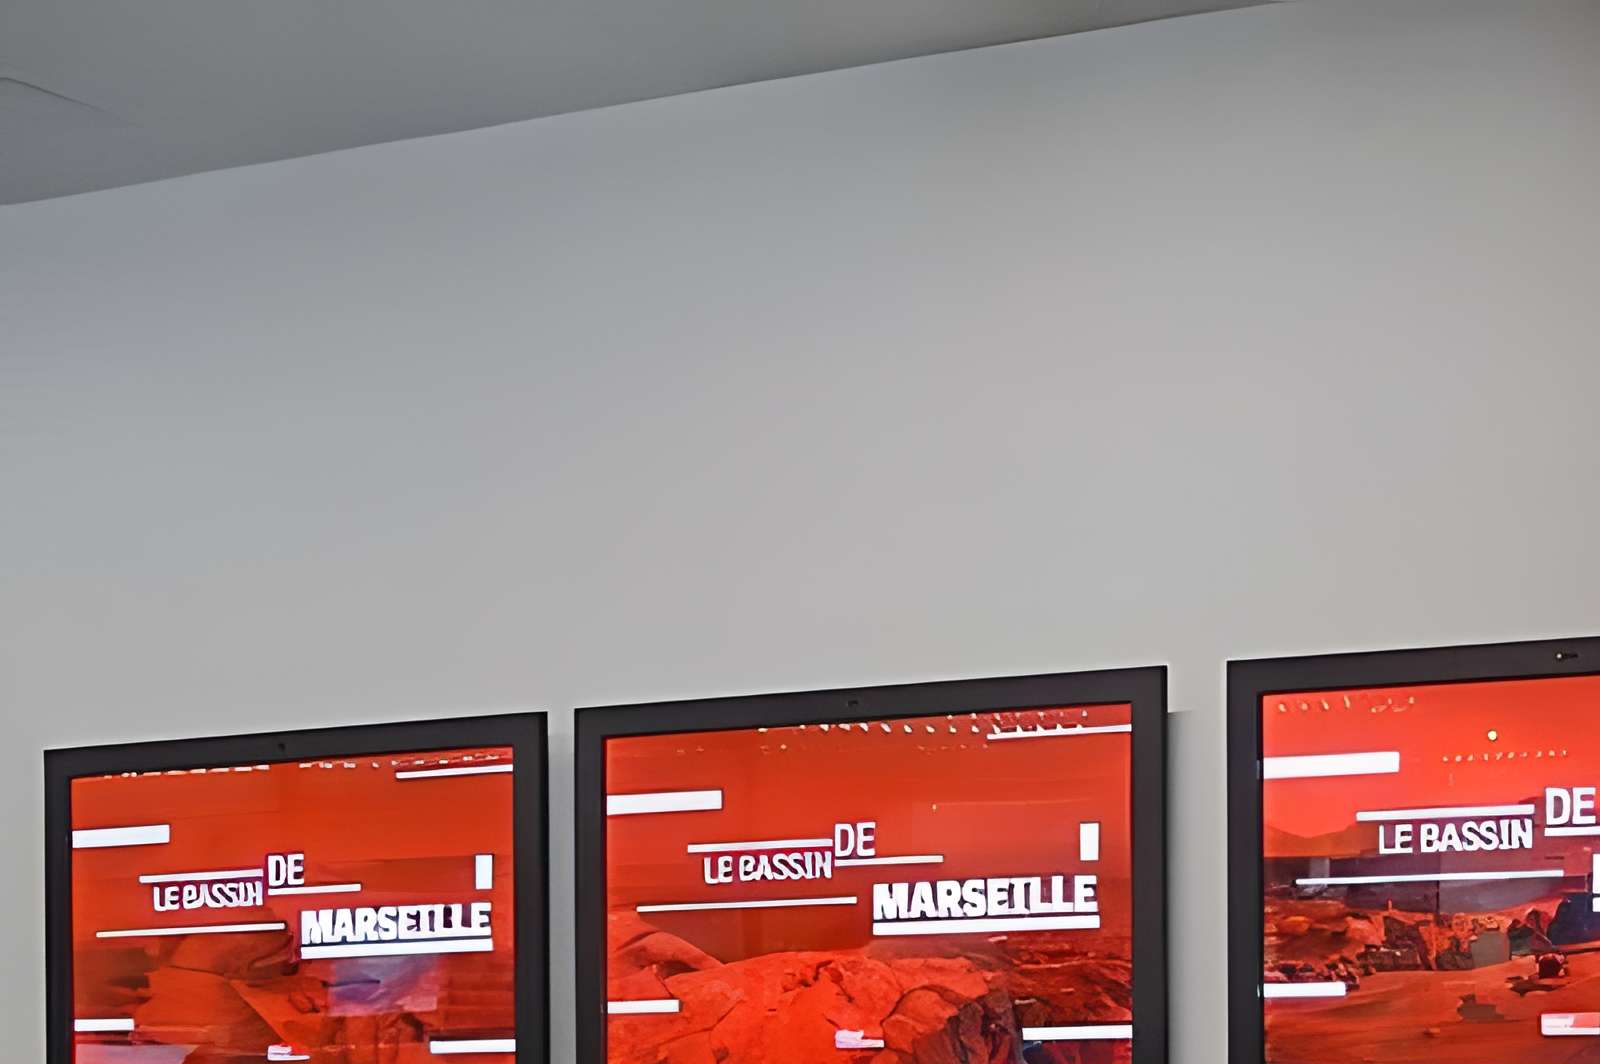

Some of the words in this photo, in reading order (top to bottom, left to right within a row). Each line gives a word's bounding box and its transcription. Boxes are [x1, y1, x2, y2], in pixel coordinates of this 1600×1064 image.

[1544, 786, 1597, 826] DE
[834, 821, 877, 858] DE
[1378, 823, 1413, 856] LE
[1419, 818, 1534, 854] BASSIN
[267, 853, 305, 887] DE
[703, 855, 734, 885] LE
[738, 850, 833, 882] BASSIN
[153, 886, 180, 912] LE
[872, 874, 1099, 921] MARSEILLE
[300, 901, 493, 946] MARSEILLE
